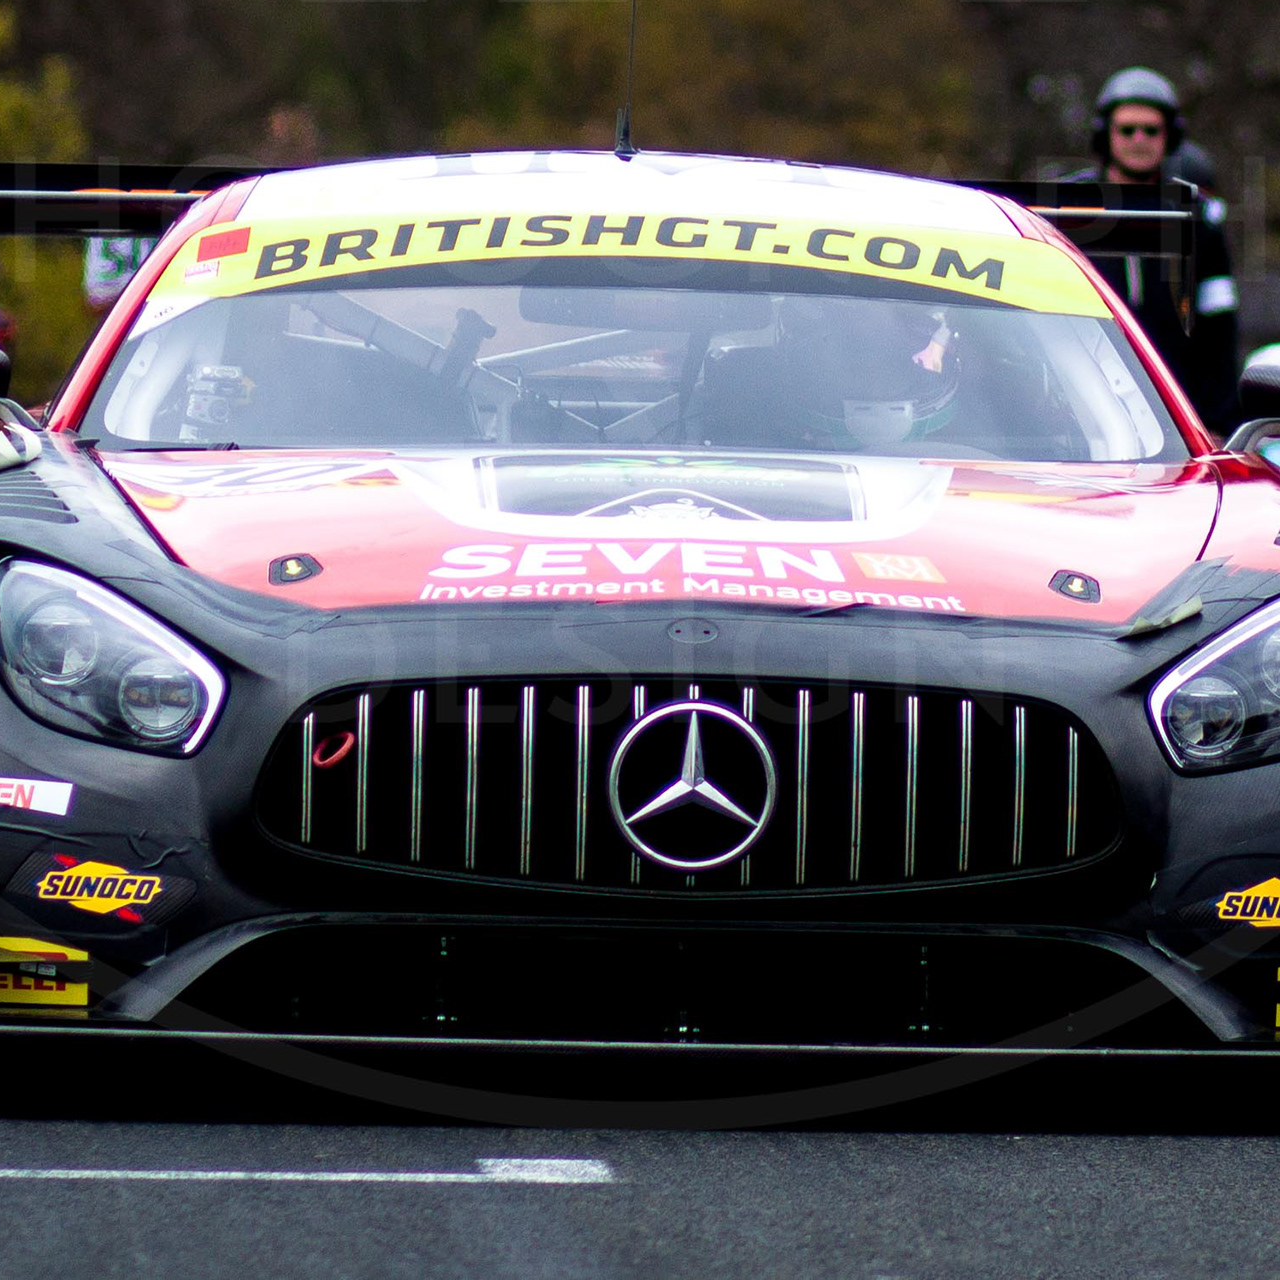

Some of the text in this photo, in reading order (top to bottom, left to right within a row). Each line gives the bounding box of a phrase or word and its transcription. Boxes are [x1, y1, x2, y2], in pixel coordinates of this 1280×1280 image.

[254, 214, 1004, 292] BRITISHGT.COM
[428, 543, 846, 583] SEVEN
[421, 577, 966, 612] Investment Management
[43, 874, 155, 901] SUNOCO
